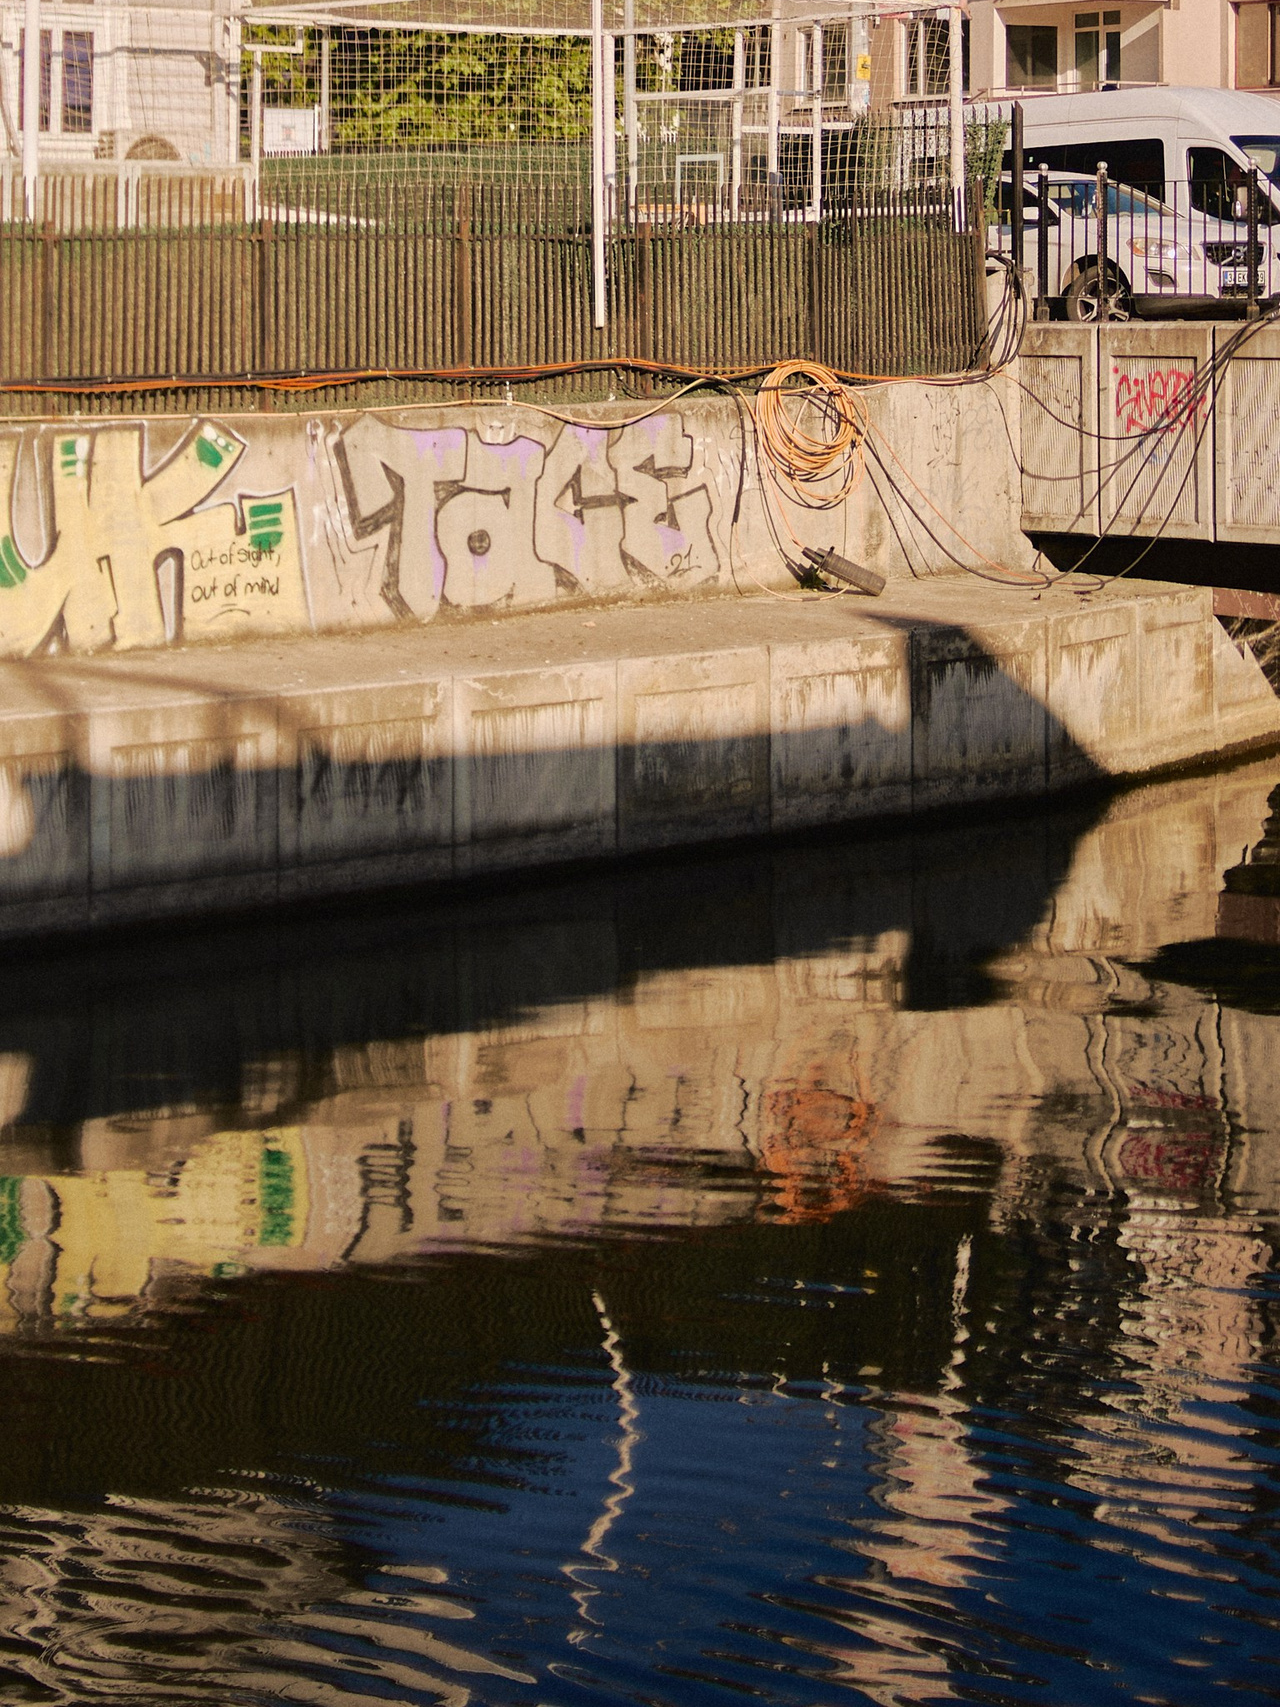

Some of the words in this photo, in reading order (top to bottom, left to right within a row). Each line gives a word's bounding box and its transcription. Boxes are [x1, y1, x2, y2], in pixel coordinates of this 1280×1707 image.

[220, 542, 236, 564] of
[191, 577, 218, 603] out
[224, 574, 240, 597] of
[244, 576, 279, 596] mind
